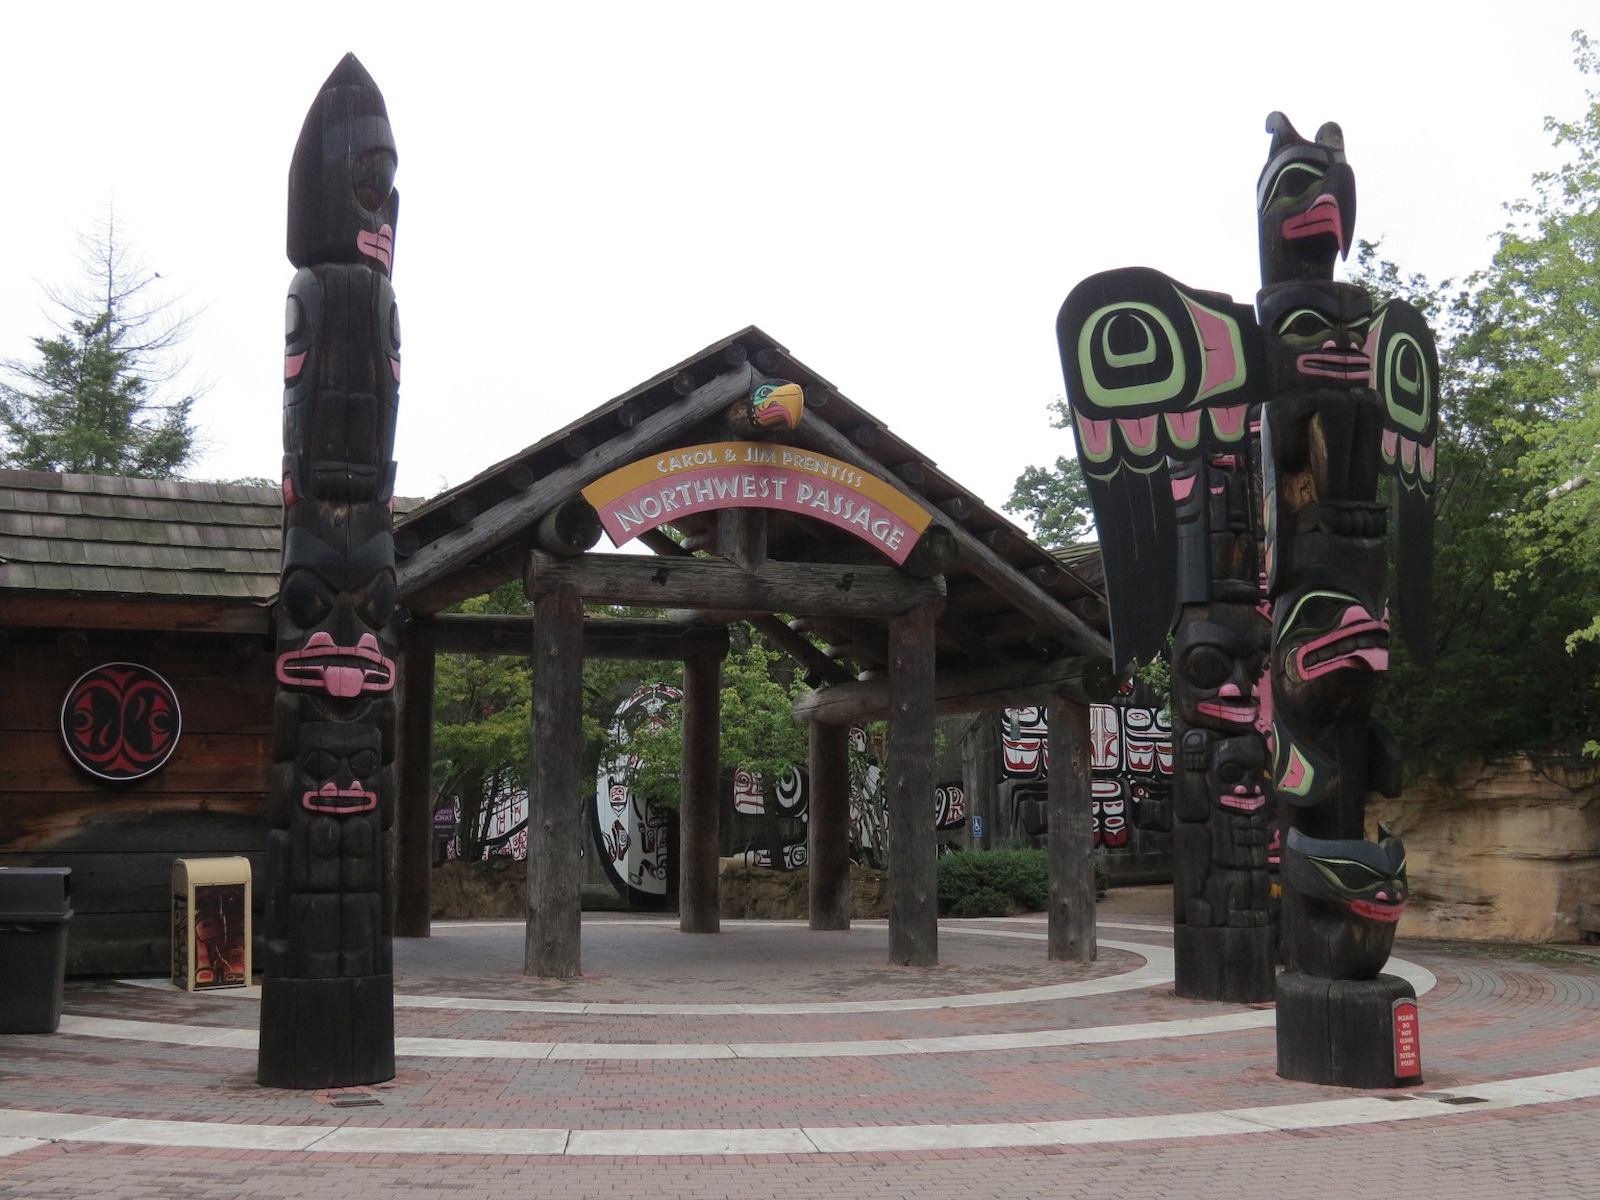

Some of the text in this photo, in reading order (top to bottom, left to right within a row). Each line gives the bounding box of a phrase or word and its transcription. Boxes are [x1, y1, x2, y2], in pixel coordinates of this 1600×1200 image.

[656, 447, 863, 488] CAROL & JIM PRENTISS
[614, 475, 905, 551] NORTHWEST PASSAGE
